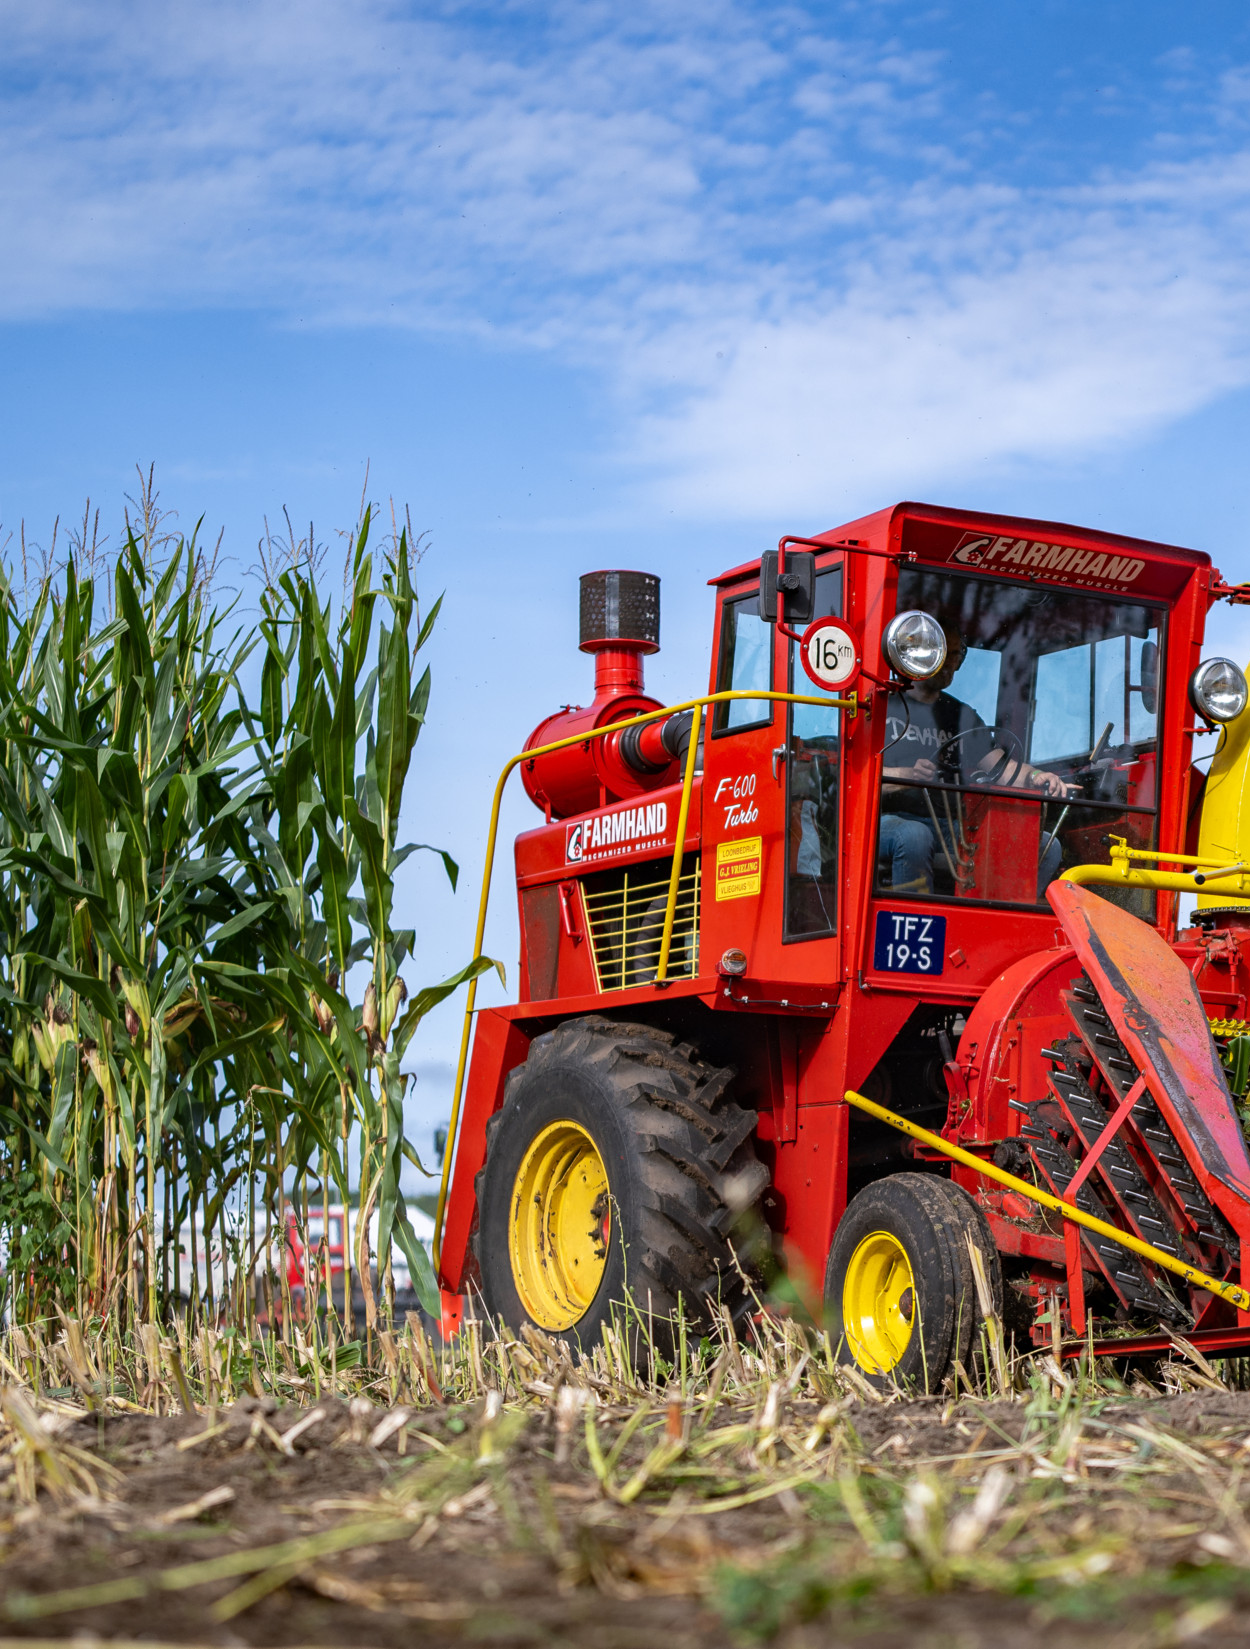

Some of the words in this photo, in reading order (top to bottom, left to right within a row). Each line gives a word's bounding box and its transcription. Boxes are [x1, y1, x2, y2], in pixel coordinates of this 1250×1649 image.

[986, 536, 1146, 582] FARMHAND
[979, 563, 1068, 582] MECHANIZED
[1075, 578, 1129, 592] MUSCLE
[815, 637, 838, 670] 16
[714, 773, 756, 803] F-600
[583, 802, 667, 850] FARMHAND
[723, 800, 759, 830] Turbo
[582, 845, 632, 862] MECHANIZED
[635, 838, 667, 850] MUSCLE
[722, 843, 757, 858] LOONBEDRIJF
[892, 915, 934, 943] TFZ
[886, 943, 931, 970] 19-S
